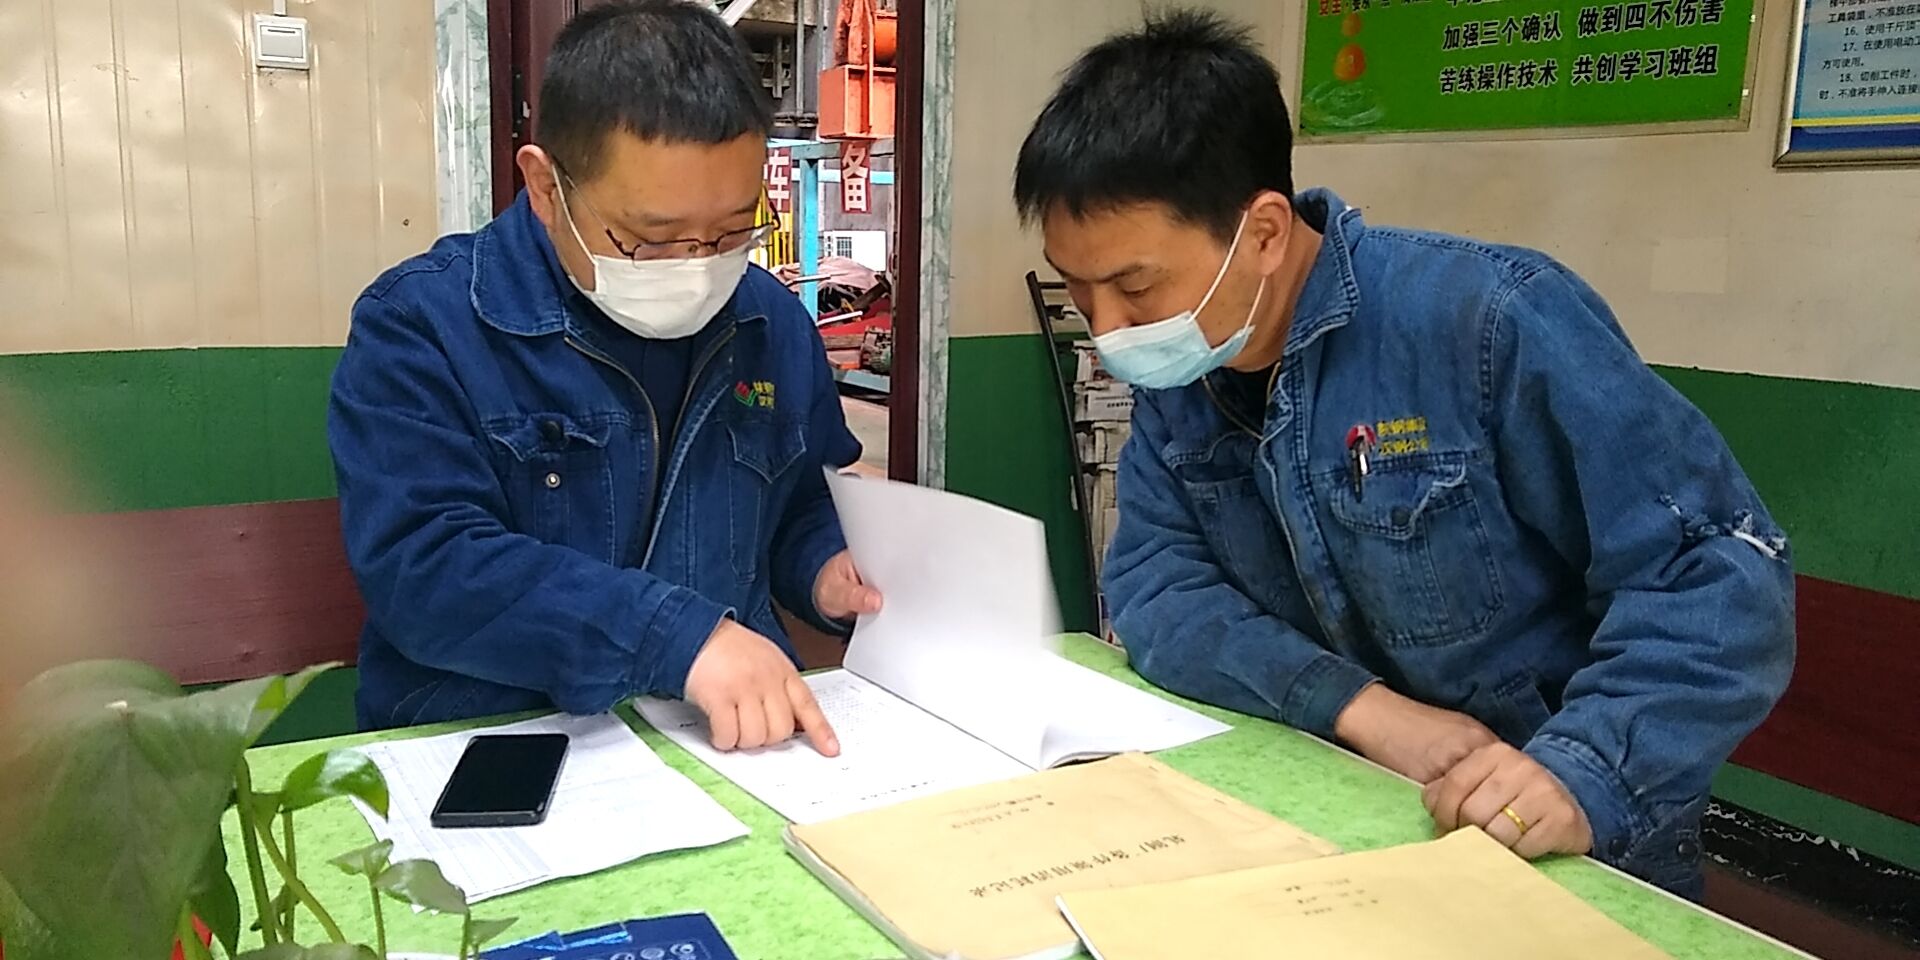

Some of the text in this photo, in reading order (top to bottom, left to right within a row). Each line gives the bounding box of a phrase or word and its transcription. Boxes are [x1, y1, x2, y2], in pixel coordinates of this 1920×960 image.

[1442, 0, 1725, 51] 加强三个确认 做到四不伤害
[1440, 44, 1719, 94] 苦练操作技术 共创学习班组
[842, 144, 869, 212] 备
